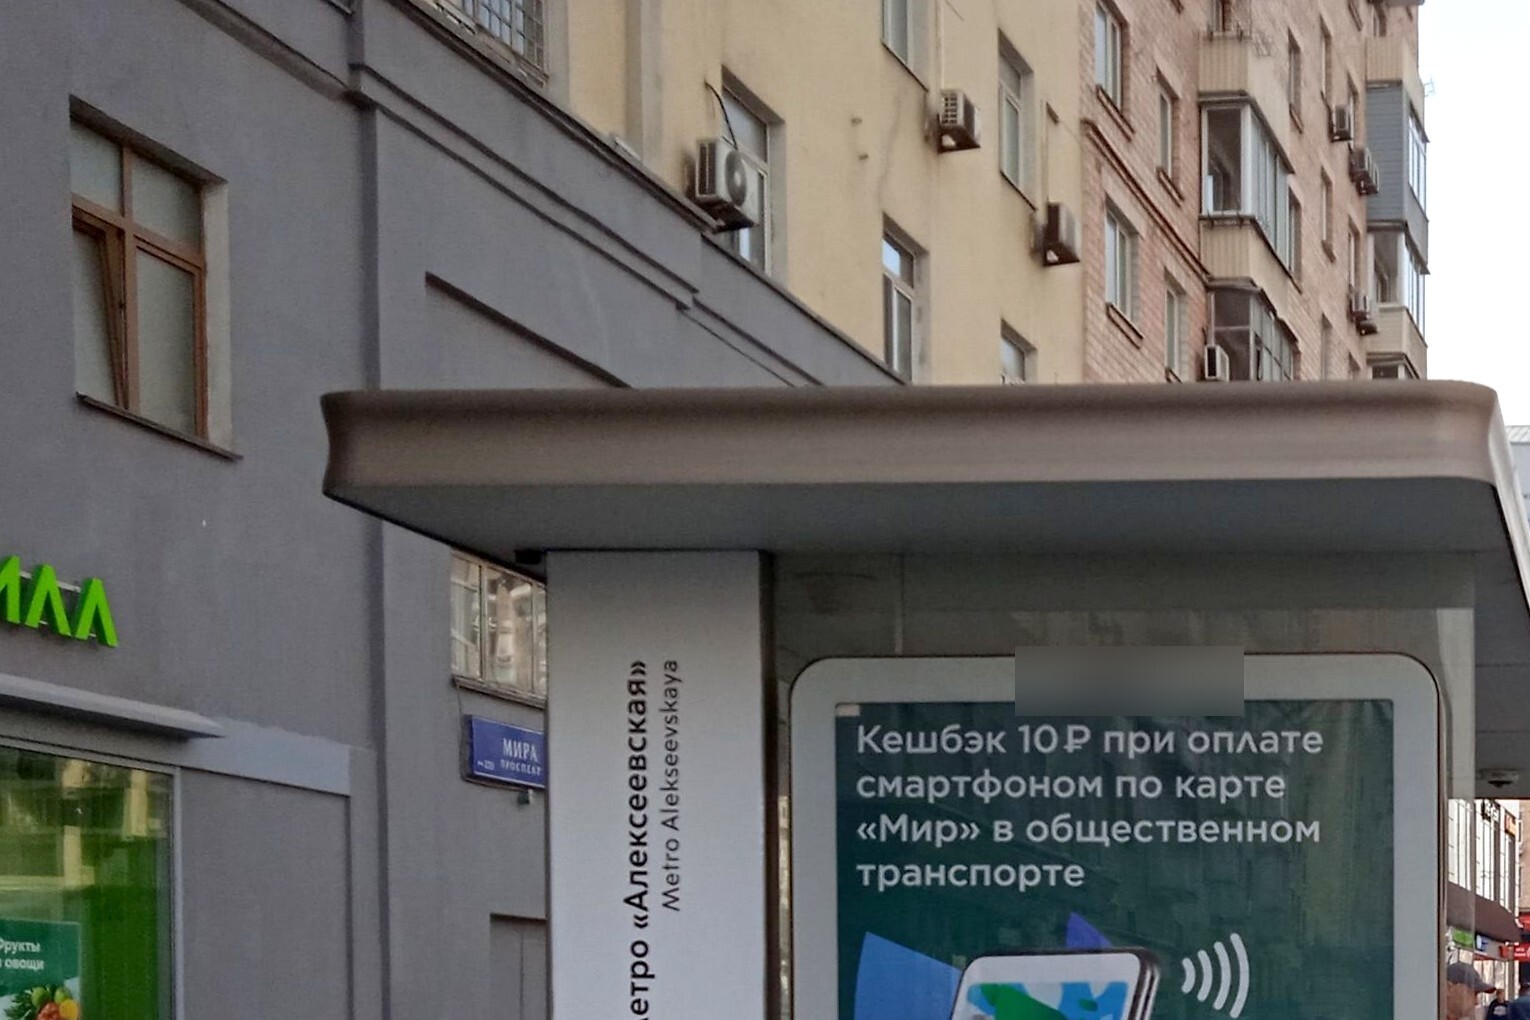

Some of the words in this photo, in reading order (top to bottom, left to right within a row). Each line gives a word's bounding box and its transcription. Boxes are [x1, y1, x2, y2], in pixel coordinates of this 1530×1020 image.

[503, 737, 538, 762] МИРА
[660, 660, 683, 831] Alekseevskaya
[857, 725, 1006, 755] Кешбэк
[1103, 731, 1175, 758] при
[1188, 730, 1323, 755] оплате
[500, 758, 541, 776] ПРОСПЕКТ
[624, 661, 650, 929] «Алексеевская»
[857, 769, 1103, 803] смартфоном
[1115, 775, 1161, 799] по
[1175, 774, 1285, 803] карте
[857, 814, 980, 846] «Мир»
[993, 819, 1014, 842] в
[1026, 814, 1320, 846] общественном
[662, 840, 680, 911] Metro
[857, 862, 1085, 891] транспорте
[5, 957, 45, 972] овощи
